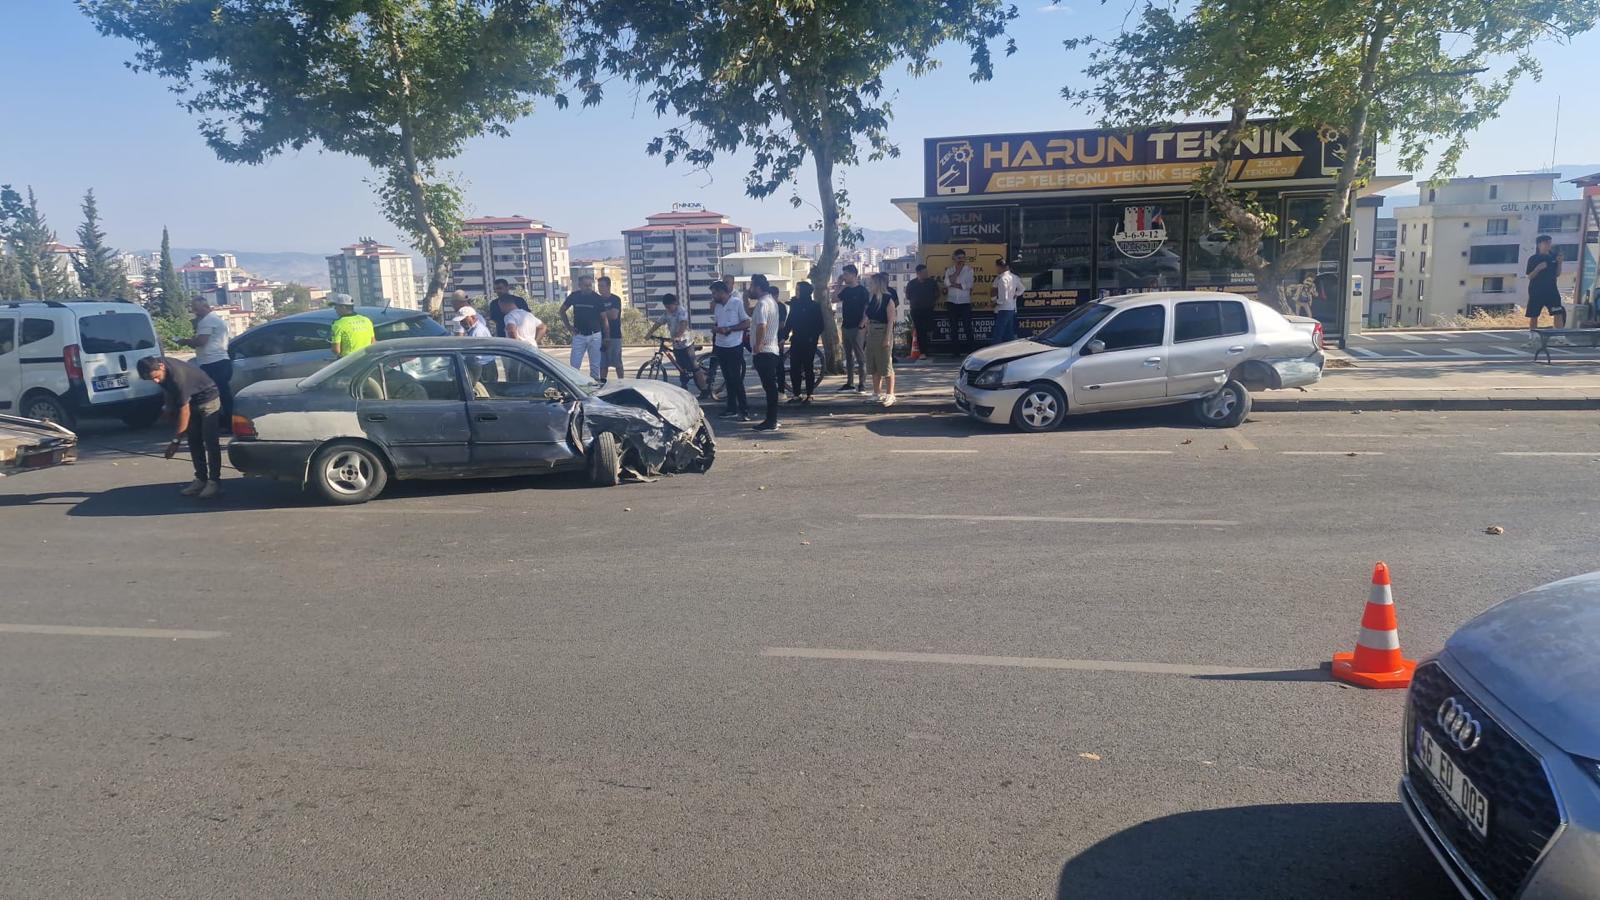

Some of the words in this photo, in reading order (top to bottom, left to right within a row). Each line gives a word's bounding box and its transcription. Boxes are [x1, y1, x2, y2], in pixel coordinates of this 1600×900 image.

[984, 135, 1134, 168] HARUN
[996, 176, 1026, 189] CEP
[1030, 170, 1109, 186] TELEFONU
[1113, 167, 1166, 182] TEKNİK
[1524, 203, 1557, 211] APART
[929, 211, 983, 224] HARUN
[950, 222, 1001, 235] TEKNİK
[1122, 230, 1158, 240] 3-6-9-12
[1461, 778, 1486, 828] 003
